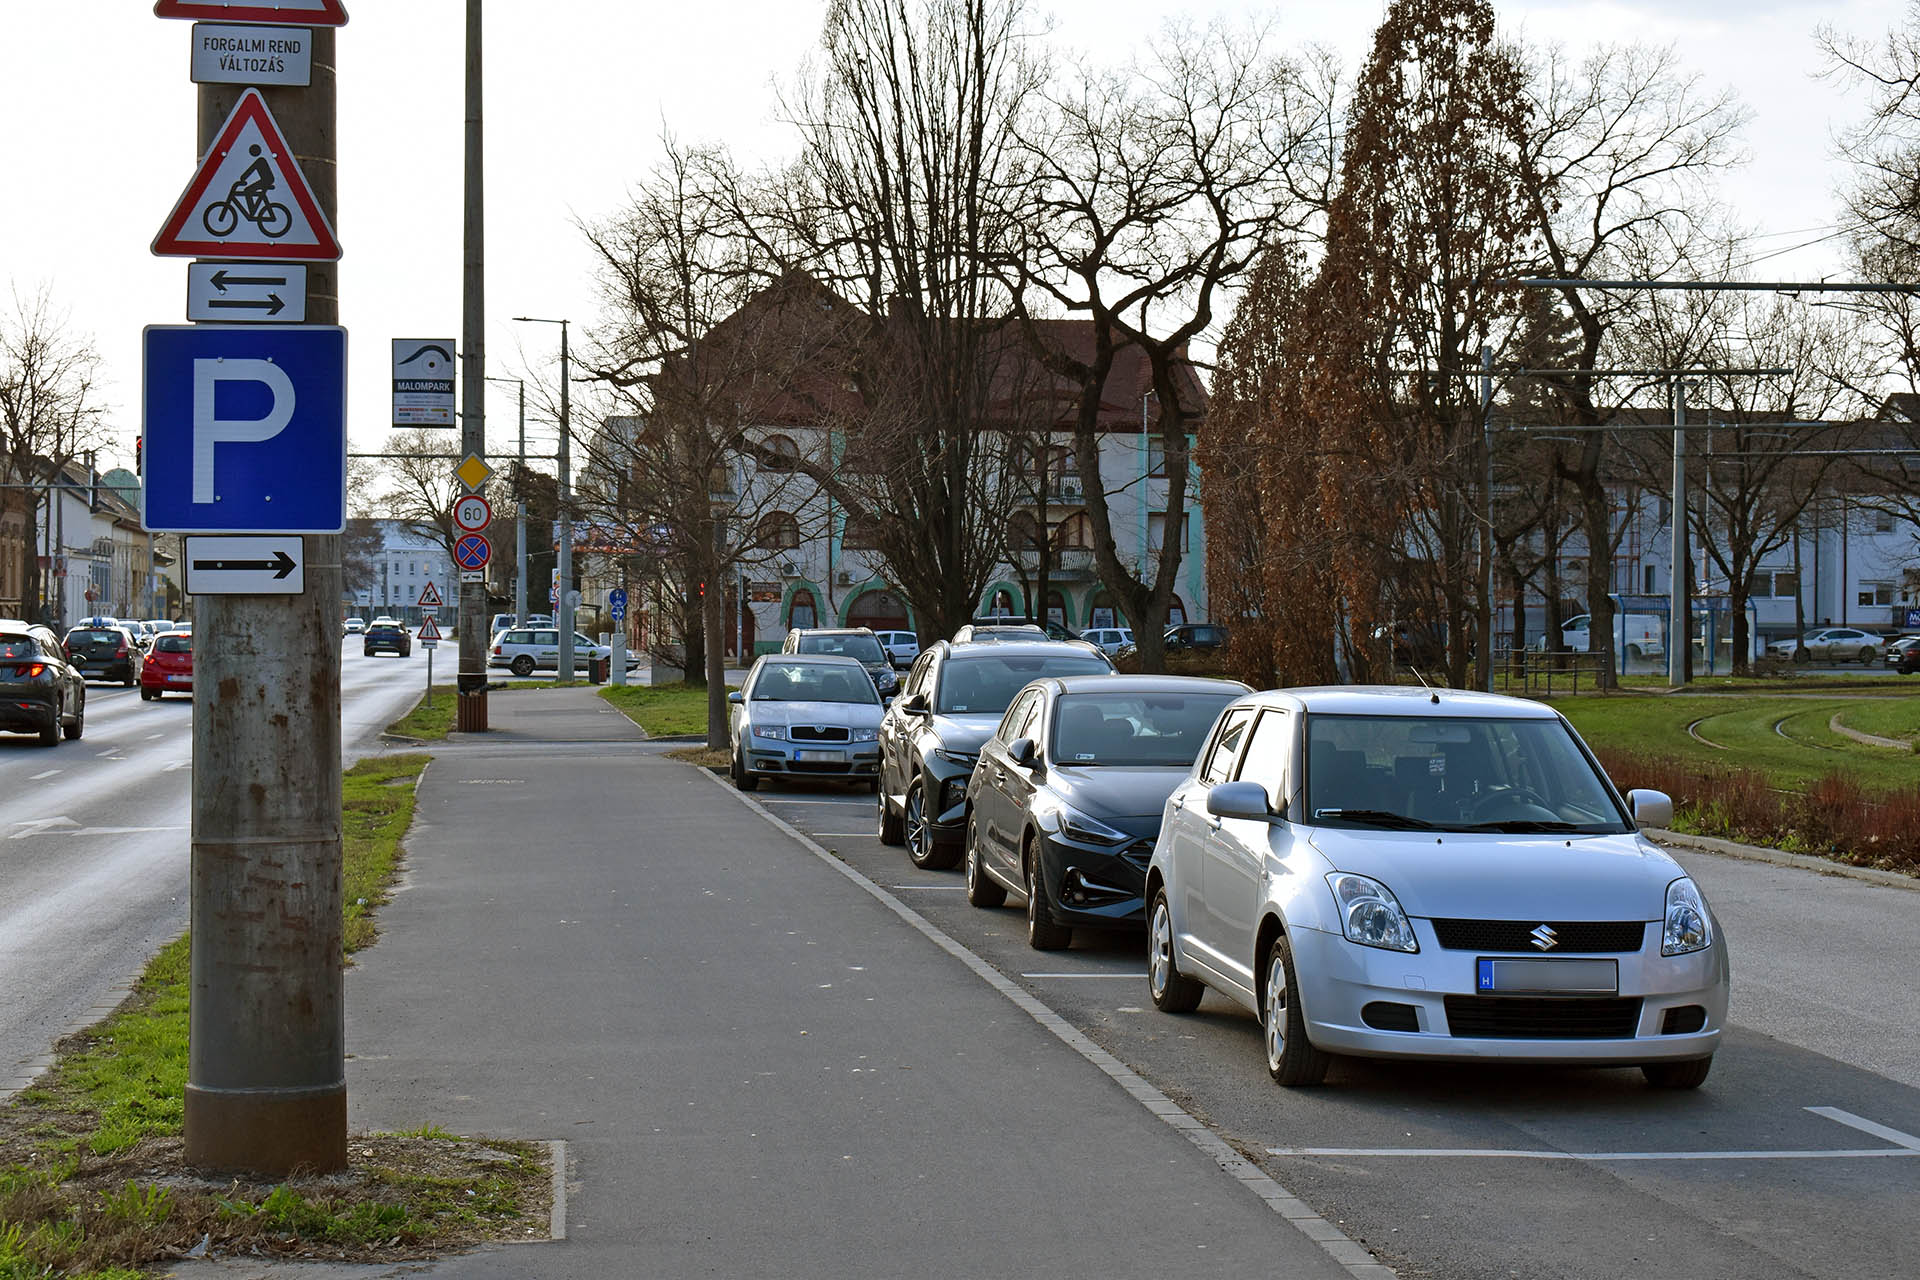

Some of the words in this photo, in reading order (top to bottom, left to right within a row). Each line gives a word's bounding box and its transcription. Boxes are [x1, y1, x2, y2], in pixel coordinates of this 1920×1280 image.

[203, 37, 265, 52] FORGALMI
[269, 40, 301, 54] REND
[220, 55, 284, 72] VÁLTOZÁS
[397, 382, 450, 391] MALOMPARK
[192, 358, 296, 504] P
[464, 507, 482, 521] 60
[1482, 976, 1490, 985] H
